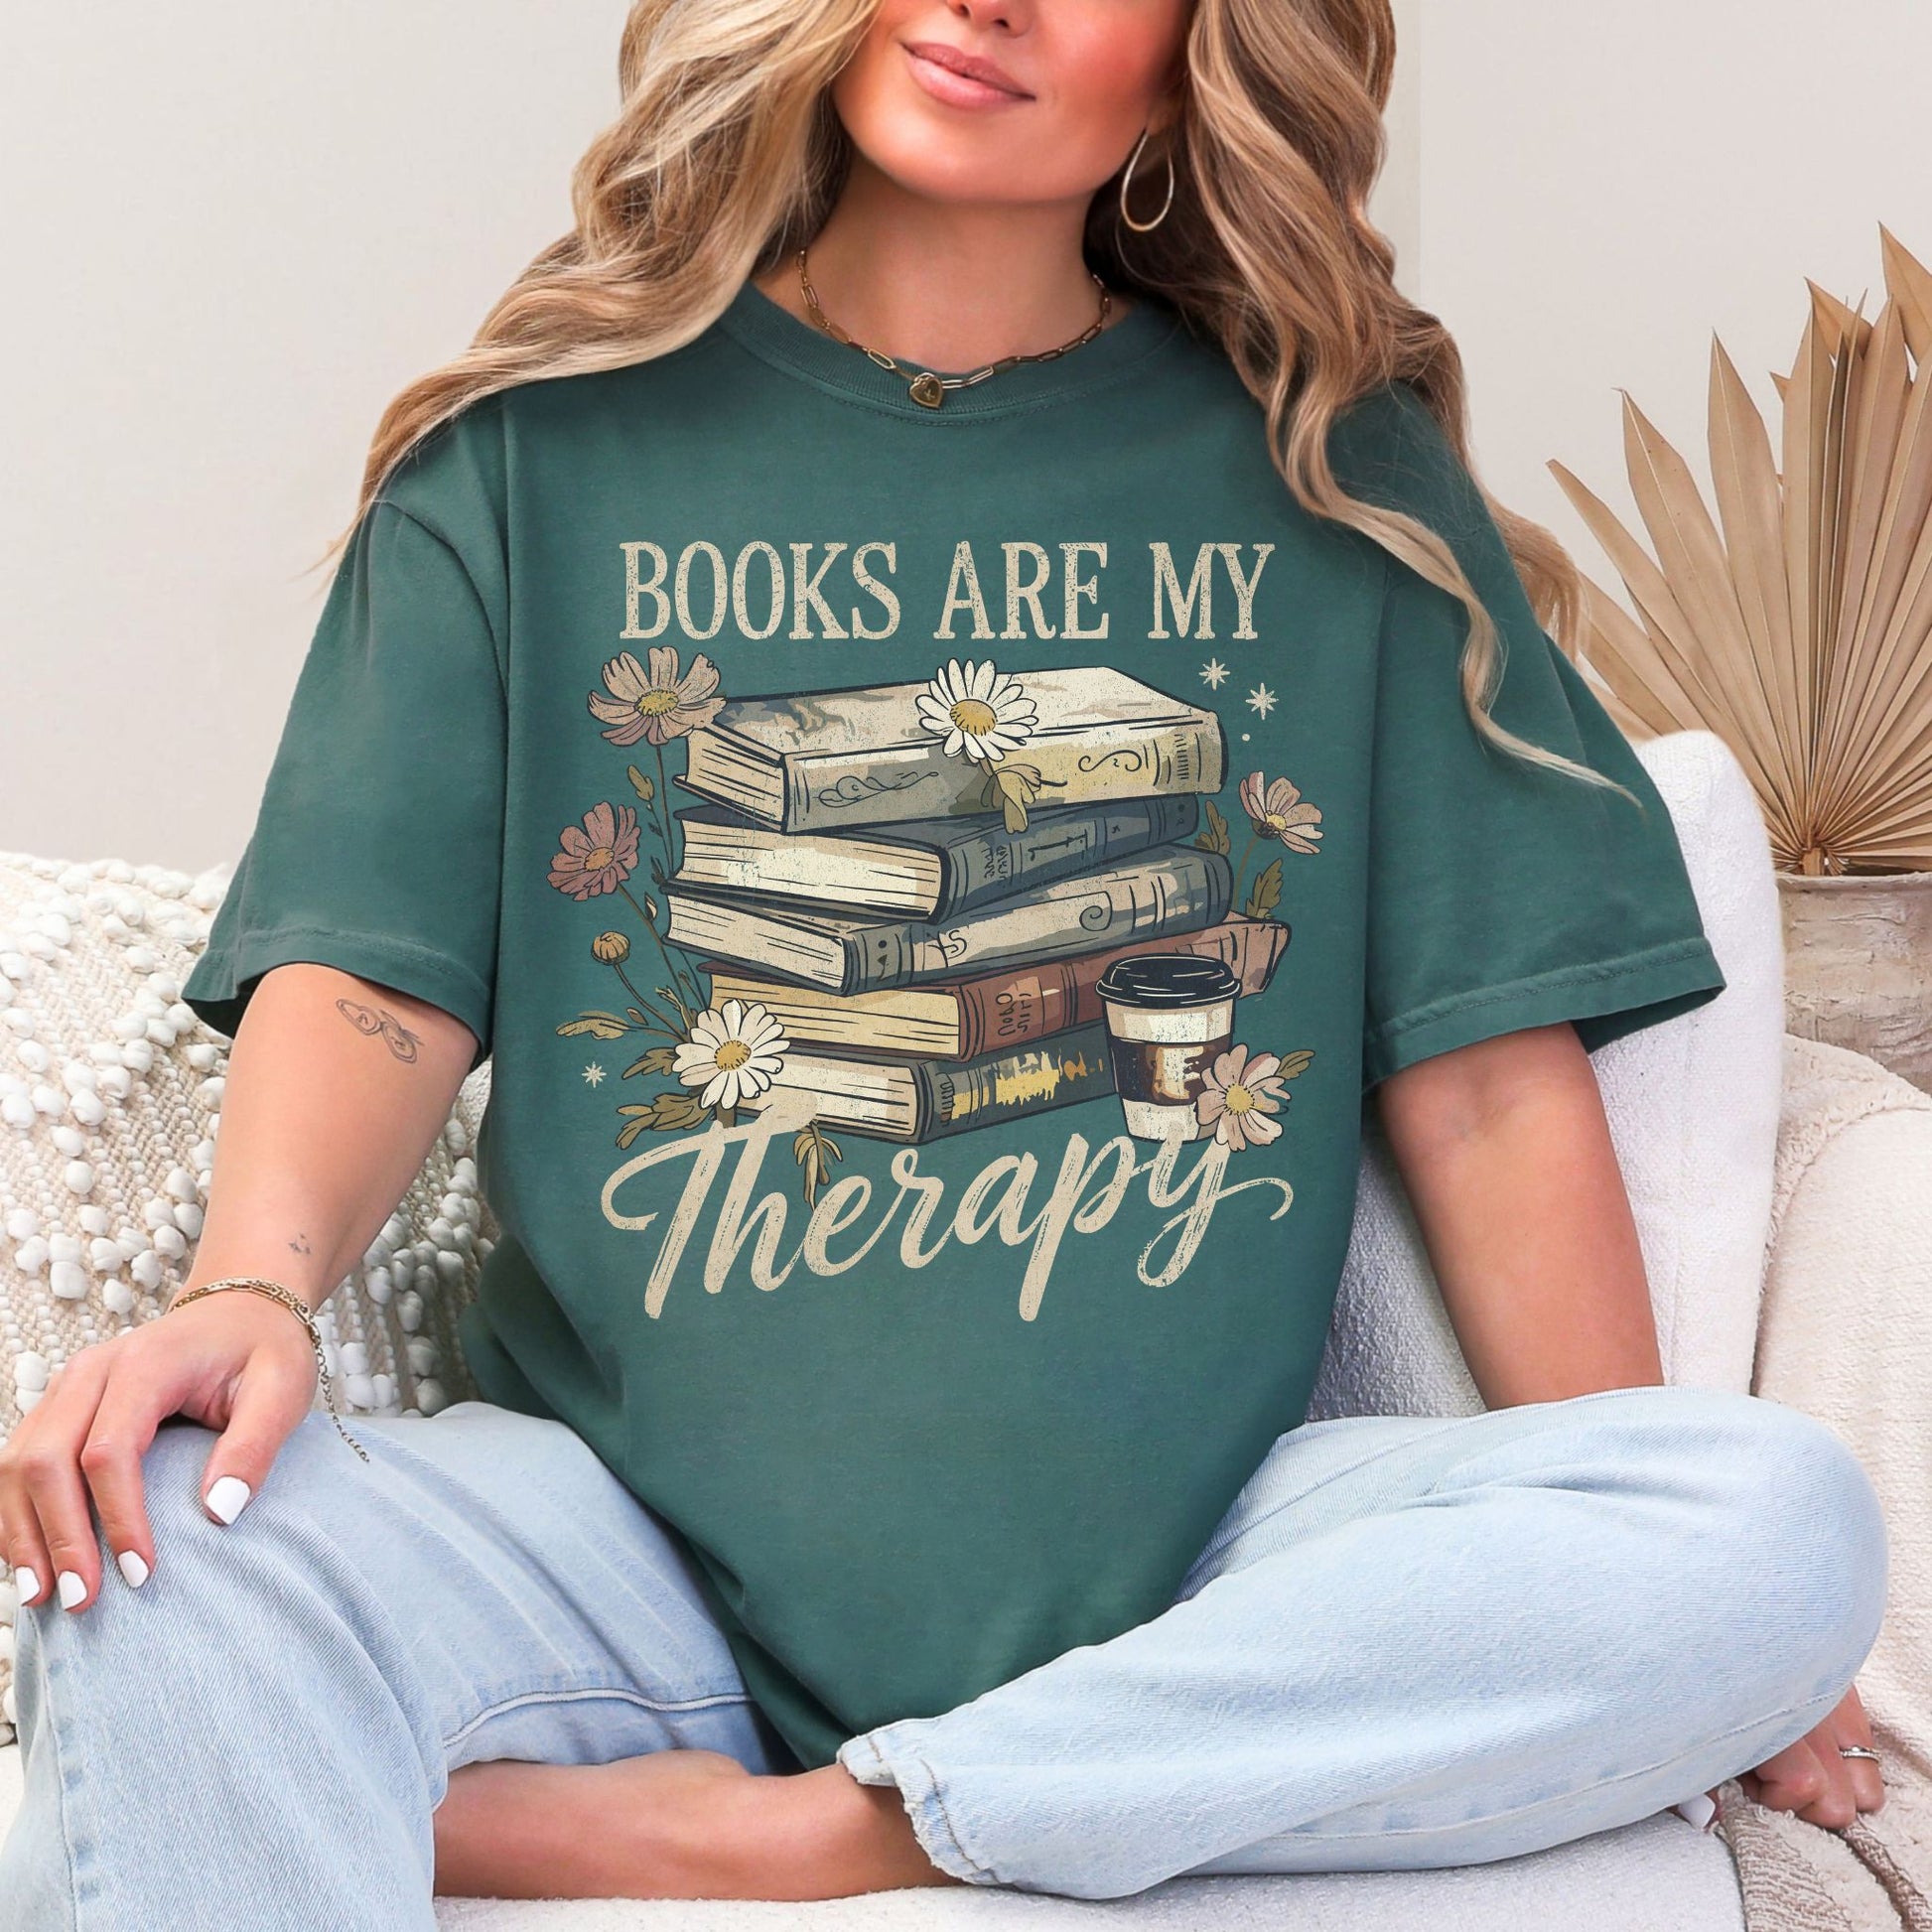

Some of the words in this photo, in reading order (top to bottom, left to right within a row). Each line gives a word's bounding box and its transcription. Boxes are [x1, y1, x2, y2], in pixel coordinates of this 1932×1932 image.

[619, 540, 900, 640] BOOKS
[933, 540, 1109, 640] ARE
[1148, 541, 1275, 640] MY
[601, 1092, 1294, 1322] Therapy
